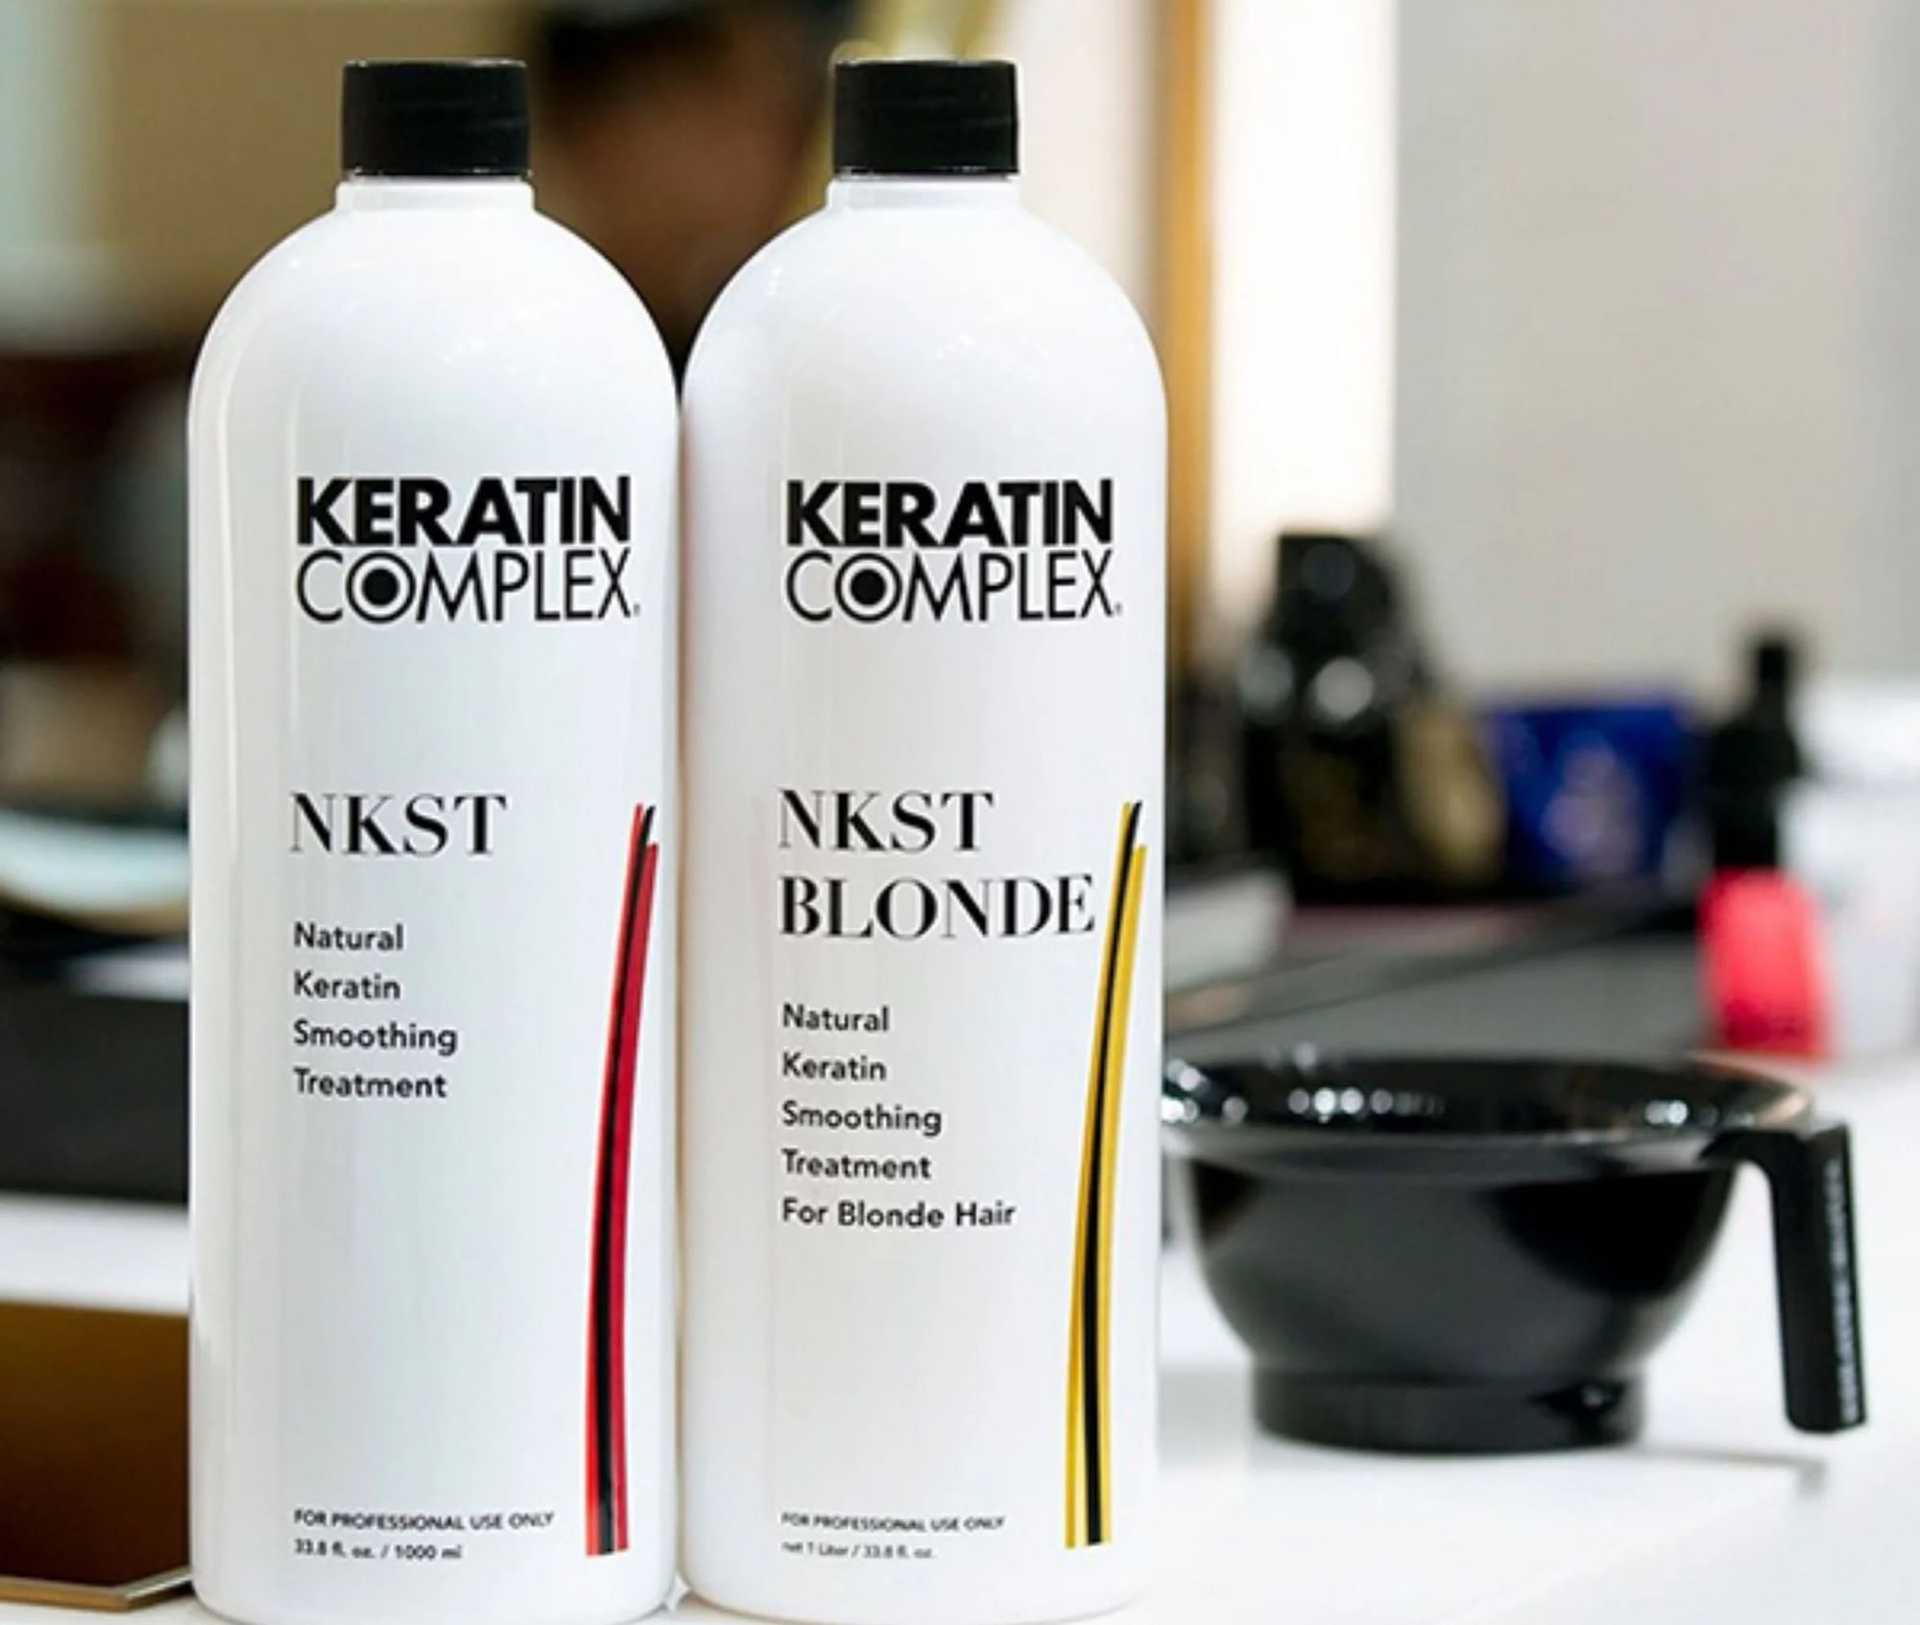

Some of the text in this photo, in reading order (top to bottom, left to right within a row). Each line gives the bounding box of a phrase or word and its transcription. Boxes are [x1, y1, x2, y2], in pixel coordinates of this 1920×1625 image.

[296, 475, 631, 546] KERATIN
[786, 478, 1114, 547] KERATIN
[290, 792, 507, 857] NKST
[778, 789, 994, 854] NKST
[779, 873, 1096, 940] BLONDE
[294, 921, 404, 951] Natural
[294, 969, 401, 1000] Keratin
[782, 1002, 890, 1032] Natural
[293, 1018, 458, 1057] Smoothing
[782, 1051, 887, 1081] Keratin
[293, 1067, 448, 1098] Treatment
[782, 1100, 942, 1137] Smoothing
[781, 1148, 932, 1179] Treatment
[782, 1196, 1017, 1227] For Blonde Hair
[294, 1509, 554, 1531] FOR PROFESSIONAL USE ONLY
[781, 1511, 1006, 1533] FOR PROFESSIONAL USE ONLY
[395, 1544, 437, 1560] 1000
